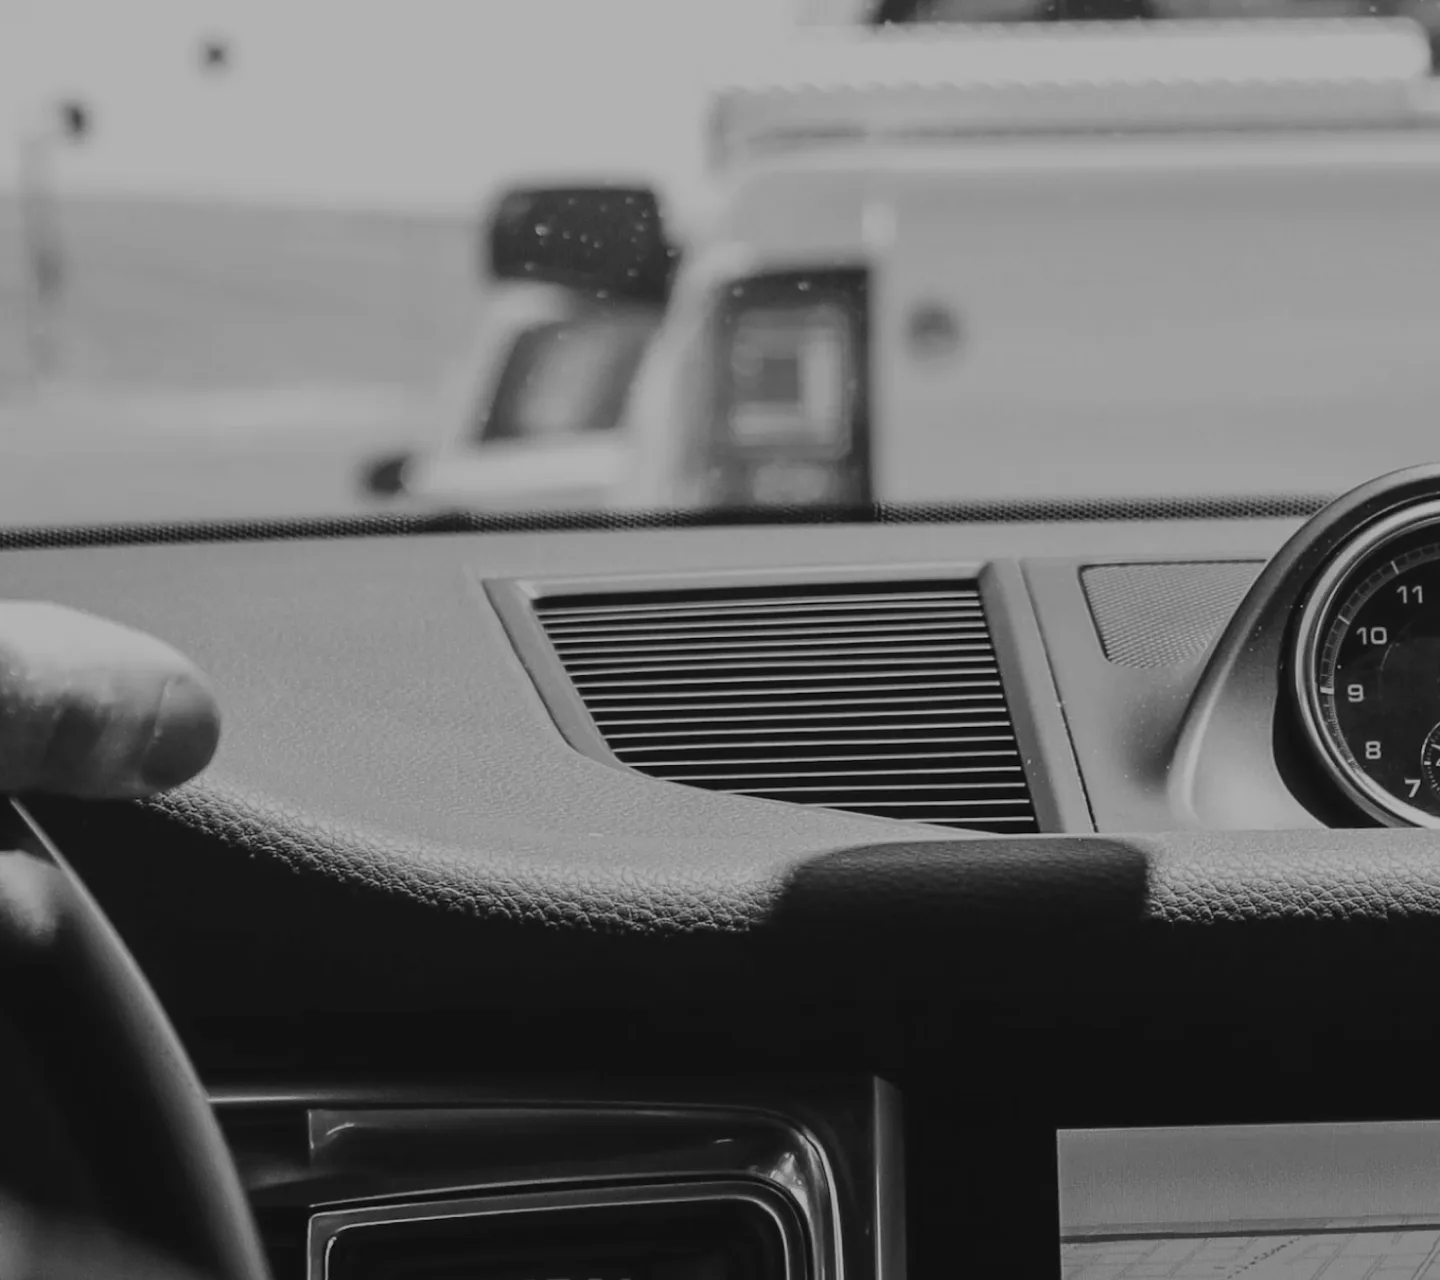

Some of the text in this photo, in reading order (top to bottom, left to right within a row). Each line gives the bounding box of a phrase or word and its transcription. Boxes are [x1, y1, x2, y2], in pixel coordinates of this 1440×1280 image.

[1397, 586, 1423, 604] 11
[1356, 627, 1387, 645] 10
[1347, 684, 1364, 702] 9
[1365, 741, 1382, 759] 8
[1404, 779, 1421, 797] 7
